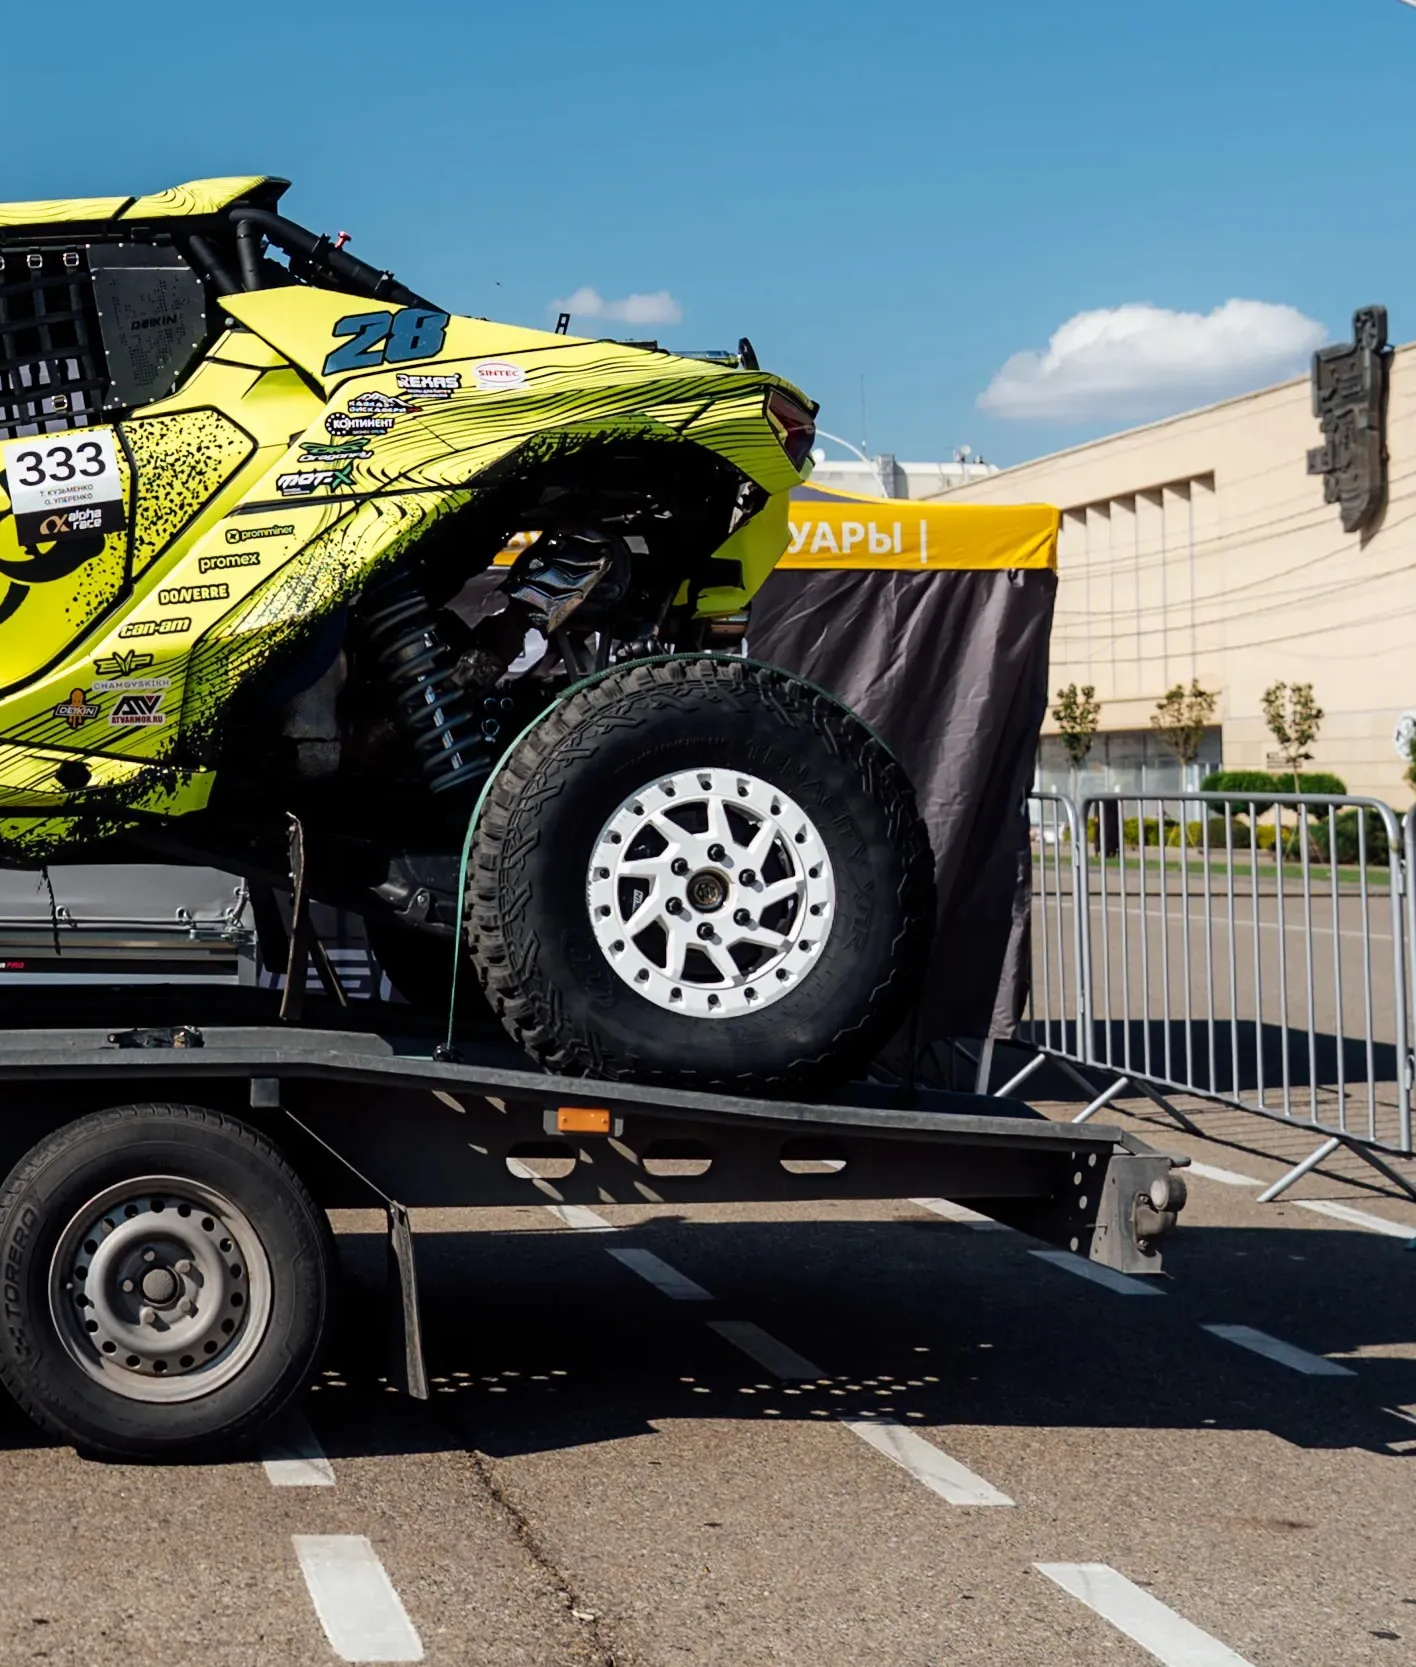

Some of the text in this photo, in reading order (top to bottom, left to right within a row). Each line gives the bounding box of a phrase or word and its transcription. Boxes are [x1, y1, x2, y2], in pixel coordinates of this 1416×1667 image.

[322, 308, 451, 377] 28
[478, 369, 520, 377] SINTEC
[397, 373, 459, 389] REXAS
[332, 418, 394, 429] КОНТИНЕНТ
[298, 450, 373, 463] Dragonfly
[16, 441, 106, 487] 333
[48, 484, 94, 496] КУЗЬМЕНКО
[54, 493, 93, 504] УПЕРЕНКО
[68, 508, 102, 522] alpha
[72, 518, 102, 531] race
[200, 554, 259, 572] promex
[120, 617, 190, 638] can-am
[111, 715, 163, 724] ATVARMOR.RU
[5, 1205, 39, 1320] TORERO
